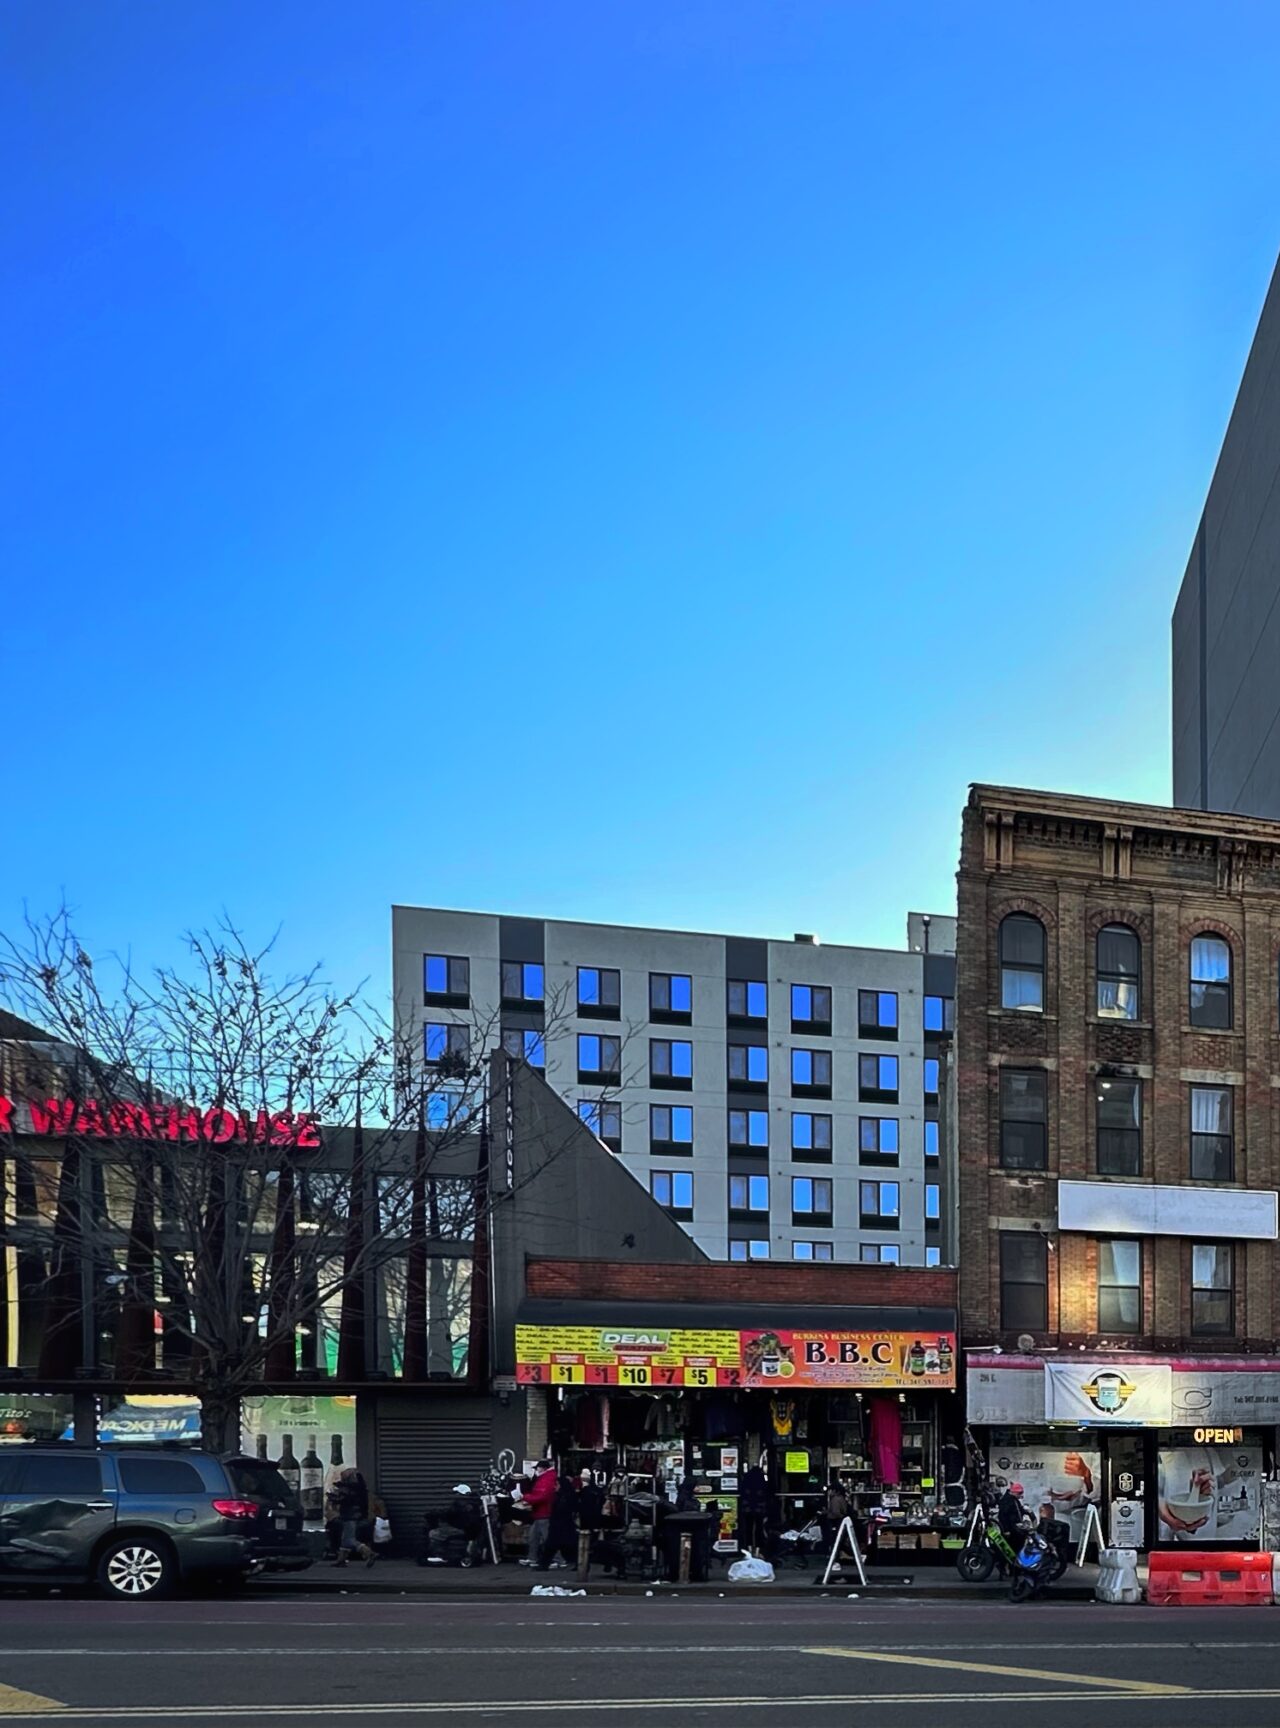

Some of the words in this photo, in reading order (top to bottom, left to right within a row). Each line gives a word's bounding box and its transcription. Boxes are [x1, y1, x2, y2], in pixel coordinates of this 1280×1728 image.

[28, 1097, 322, 1147] WAREHOUSE
[604, 1333, 665, 1344] DEAL
[831, 1332, 871, 1341] BUSINESS
[524, 1365, 542, 1382] $3
[559, 1366, 573, 1382] $1
[595, 1367, 609, 1383] $1
[623, 1367, 648, 1384] $10
[660, 1368, 676, 1384] $7
[691, 1368, 708, 1385] $5
[724, 1369, 740, 1385] $2
[1194, 1427, 1234, 1443] OPEN
